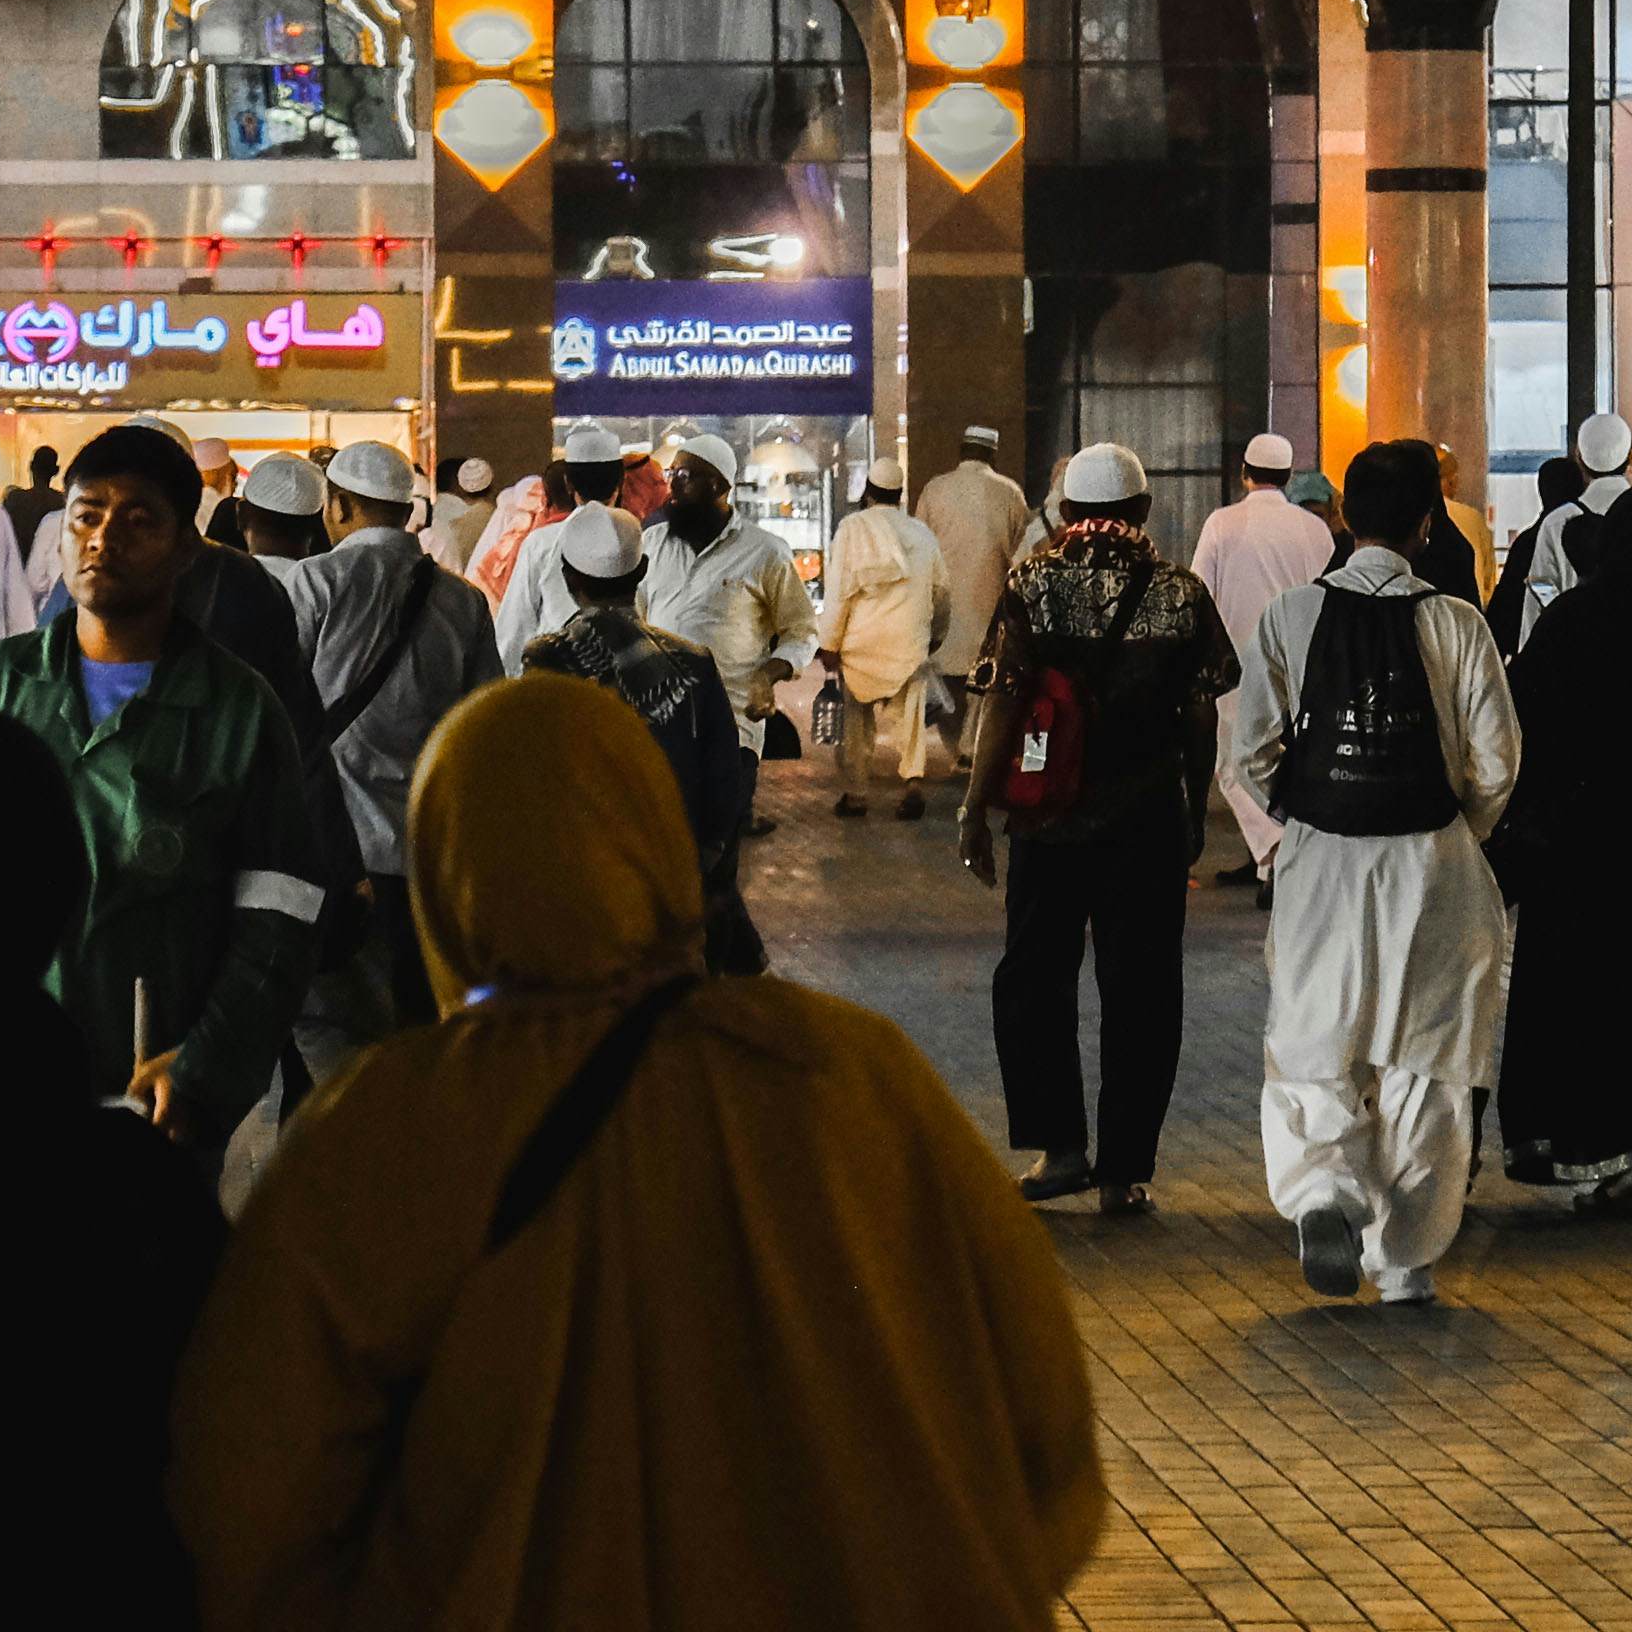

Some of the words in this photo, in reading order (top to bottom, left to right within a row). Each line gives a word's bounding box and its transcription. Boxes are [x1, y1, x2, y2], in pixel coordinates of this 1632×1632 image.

[79, 299, 229, 358] مارك
[246, 299, 386, 368] هاي
[606, 318, 711, 349] القرشي
